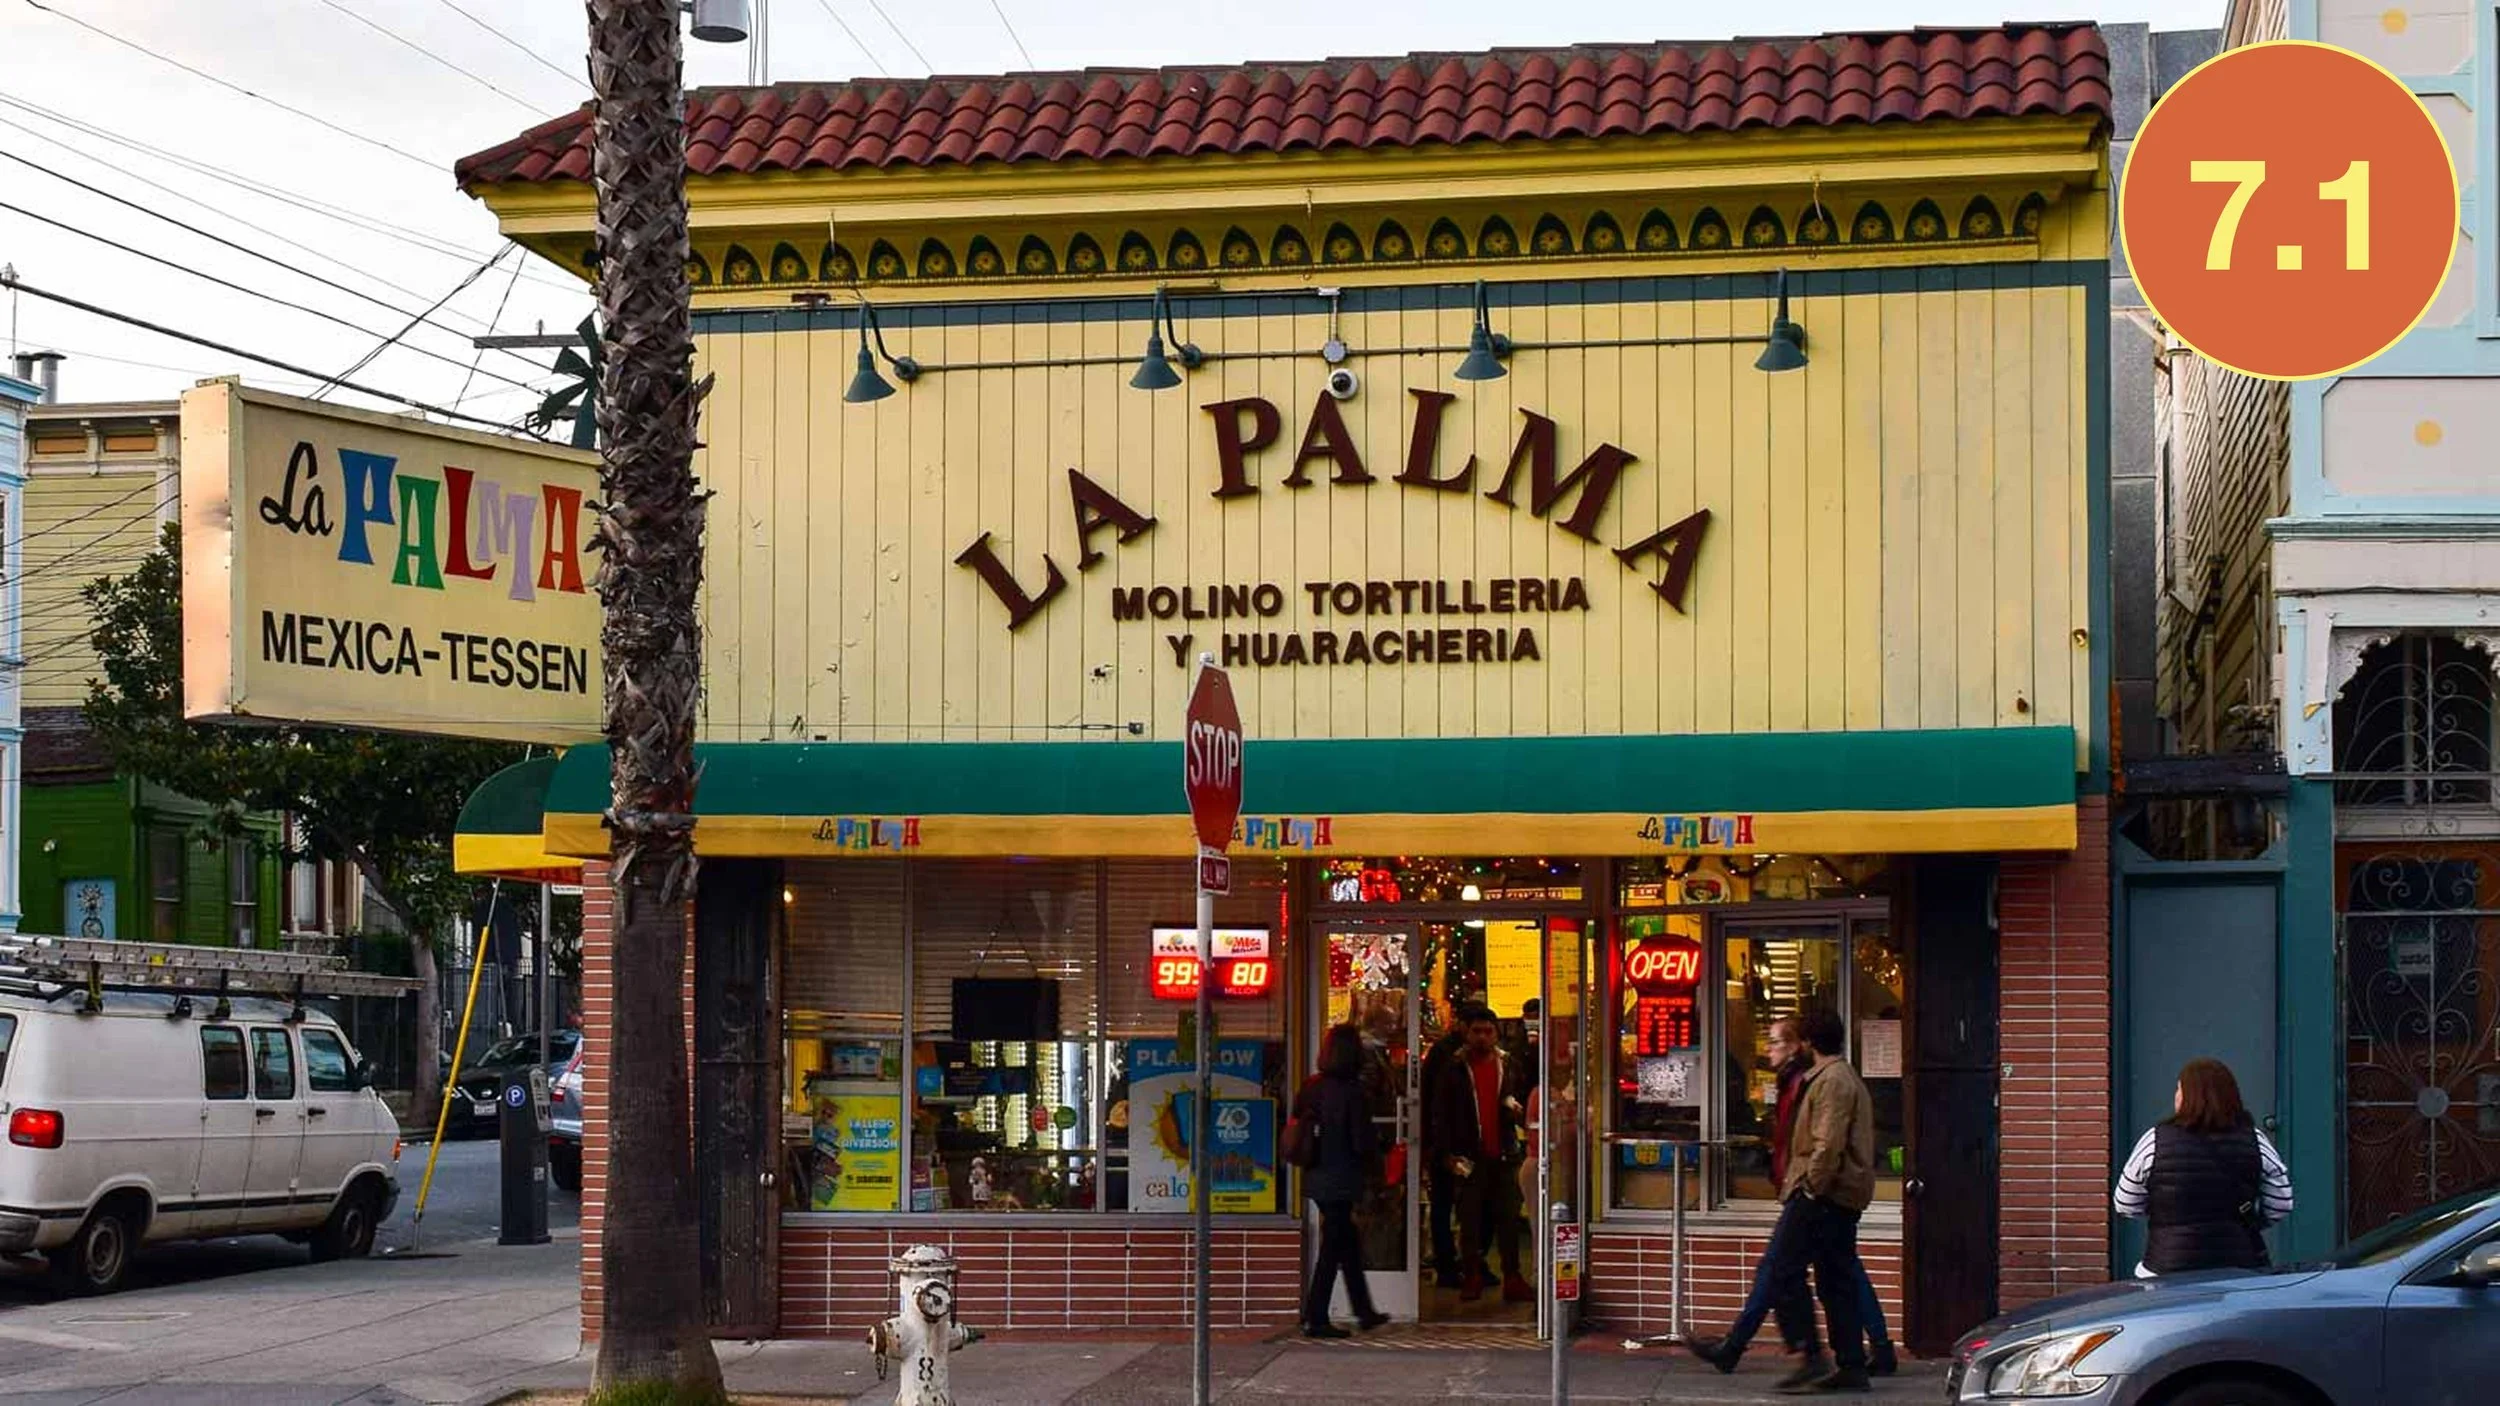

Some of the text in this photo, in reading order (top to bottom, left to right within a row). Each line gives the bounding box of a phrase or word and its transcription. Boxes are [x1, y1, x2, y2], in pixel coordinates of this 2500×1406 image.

[260, 441, 586, 602] La PALMA
[953, 386, 1713, 632] LA PALMA
[1112, 576, 1592, 622] MOLINO TORTILLERIA
[262, 610, 587, 694] MEXICA-TESSEN
[1167, 627, 1541, 668] Y HUARACHERIA
[1190, 720, 1240, 789] STOP
[837, 817, 921, 851] PALMA
[1245, 817, 1333, 850] PALMA
[1662, 815, 1755, 849] PALMA
[1231, 962, 1268, 987] 80
[1630, 950, 1699, 980] OPEN
[1136, 1049, 1186, 1067] PLA
